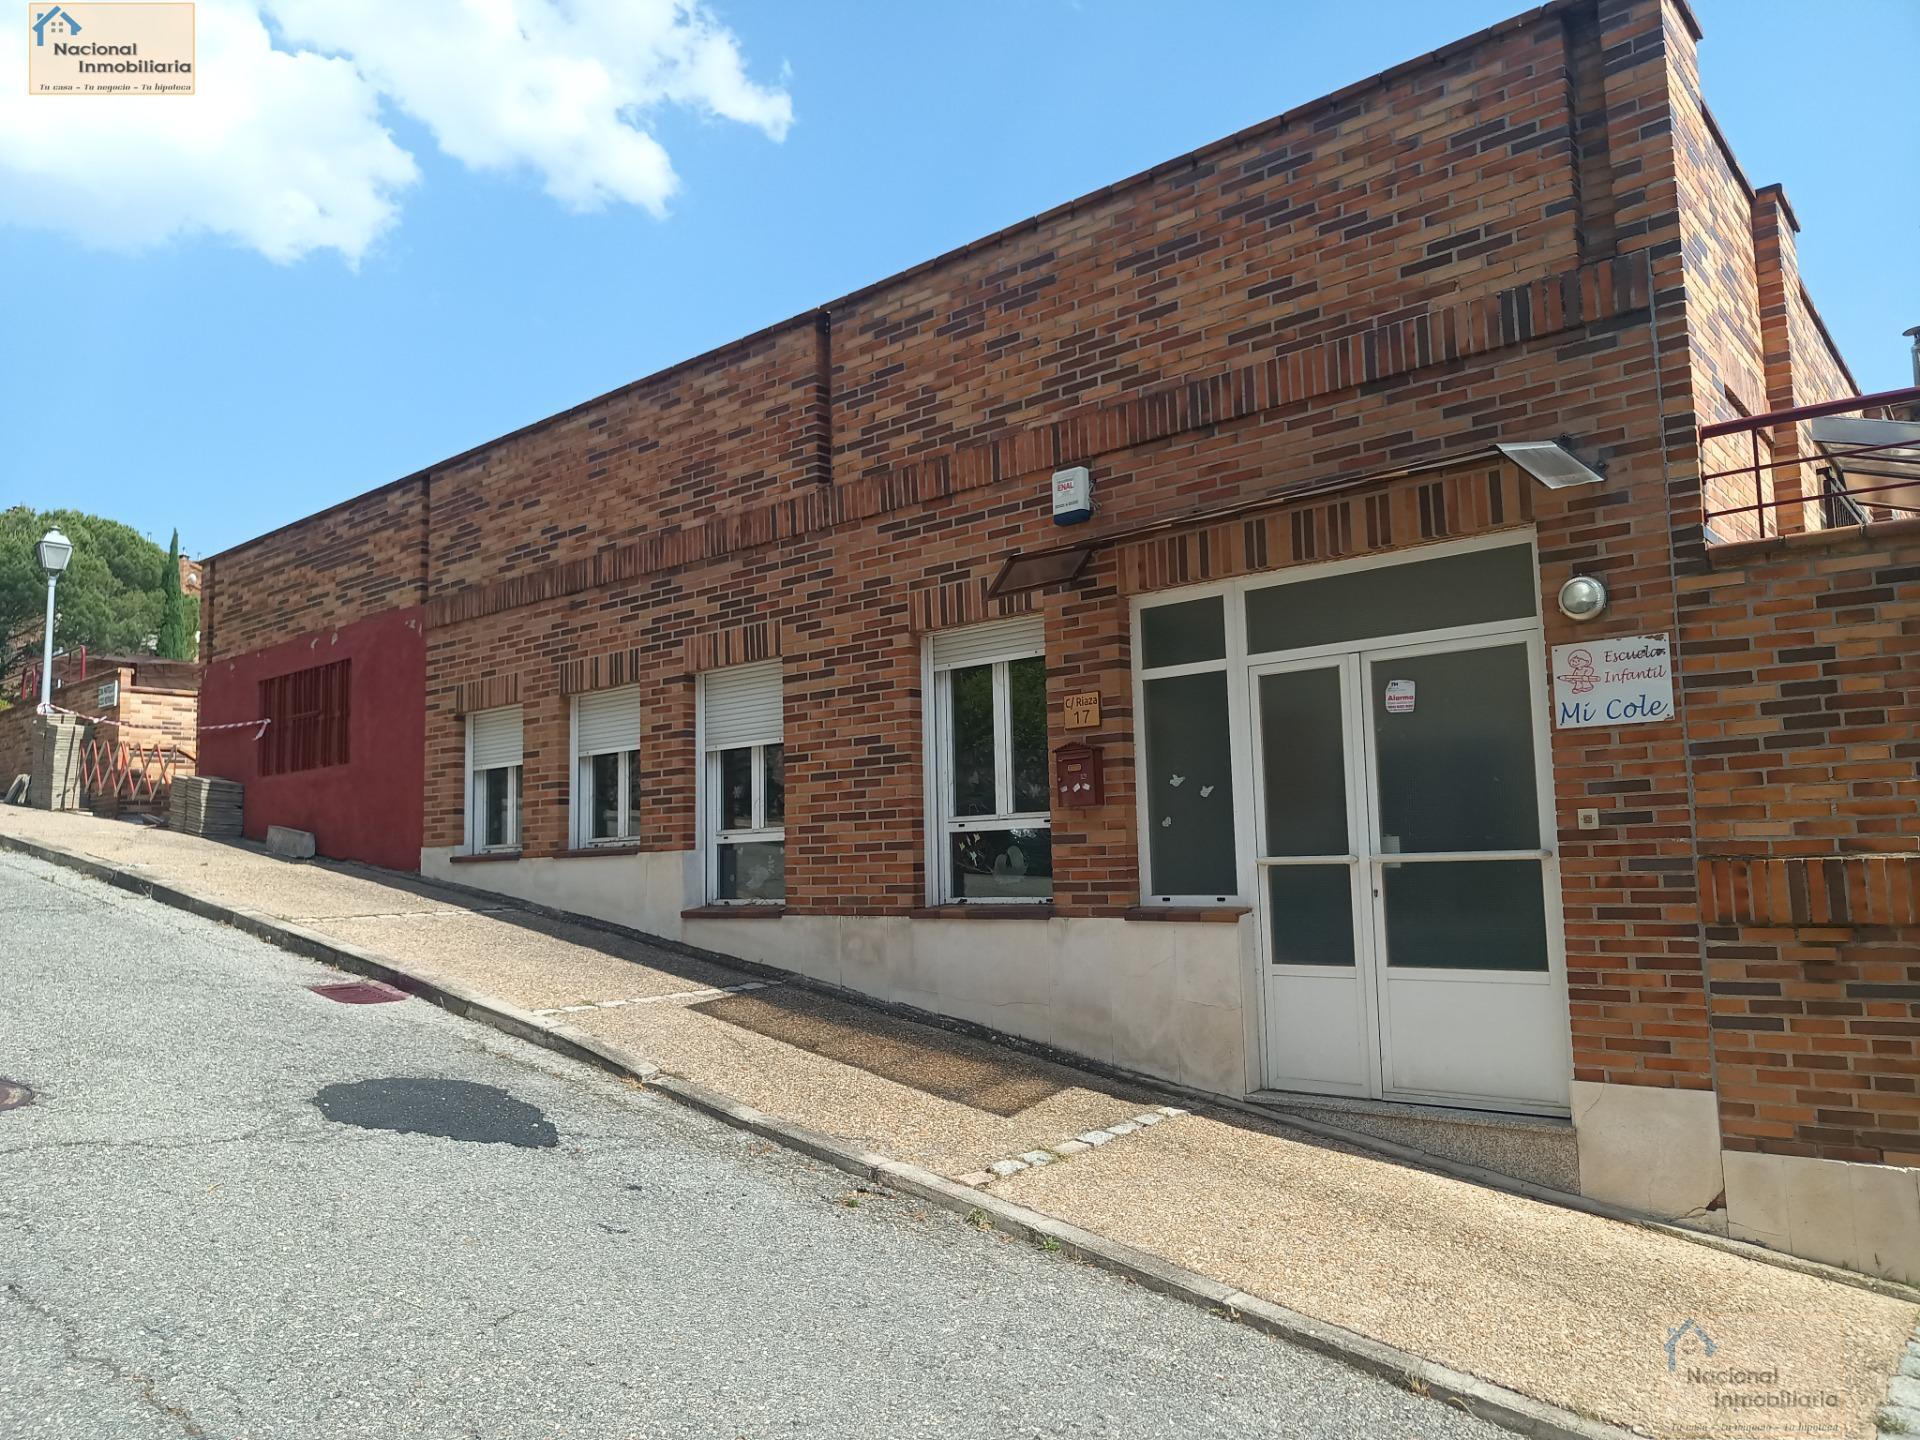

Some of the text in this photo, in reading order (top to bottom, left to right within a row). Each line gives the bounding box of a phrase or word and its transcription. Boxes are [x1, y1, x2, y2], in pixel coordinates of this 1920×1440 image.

[1604, 645, 1666, 663] Escuela
[1604, 665, 1667, 684] Infantil
[1065, 696, 1098, 710] C/ Riaza
[1560, 694, 1668, 726] Mi Cole
[1073, 709, 1090, 725] 17
